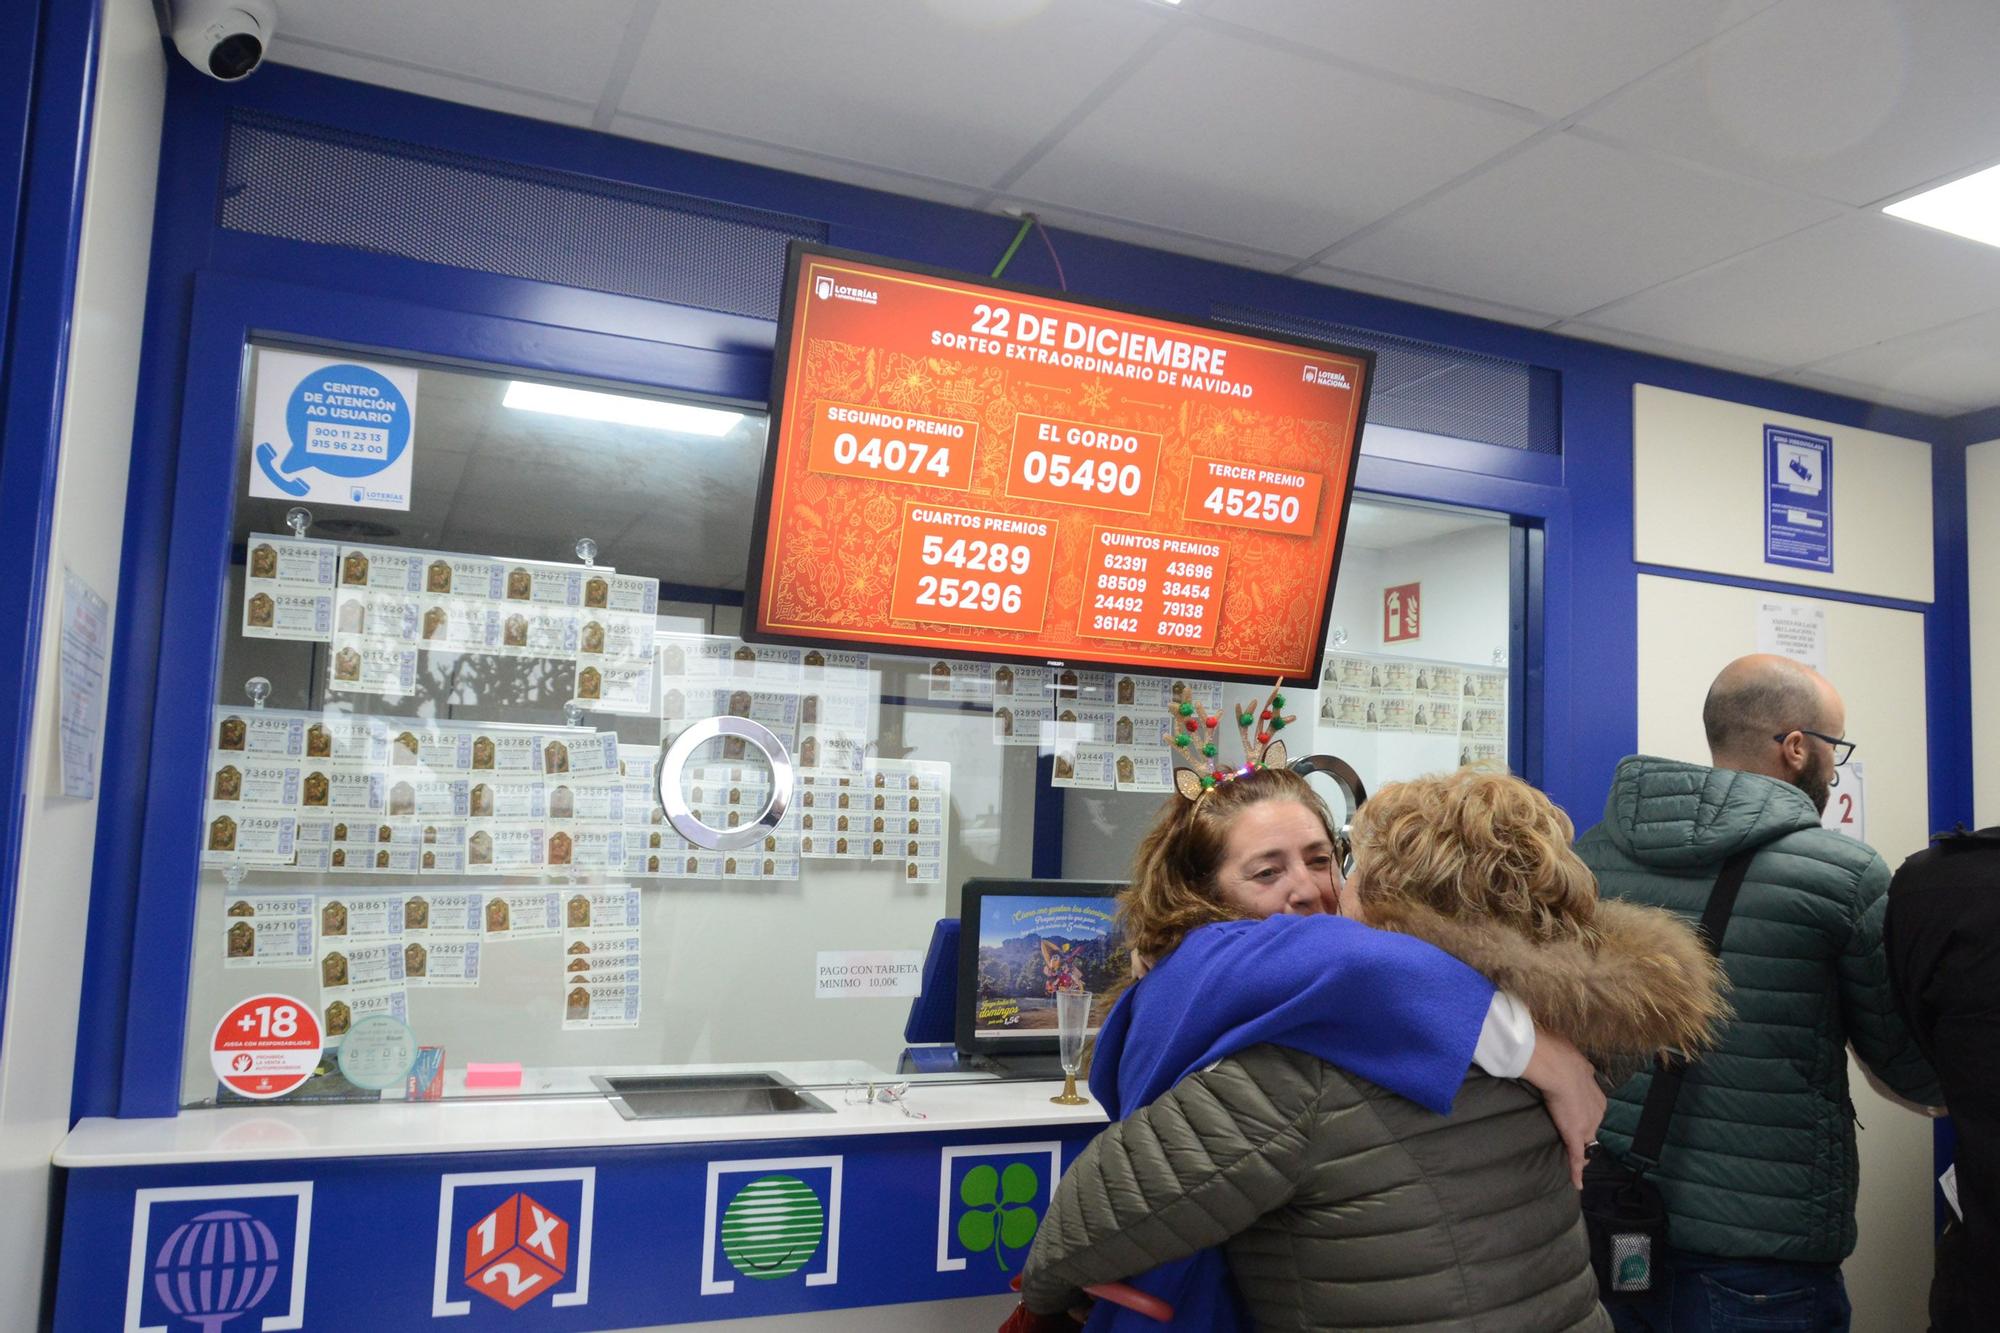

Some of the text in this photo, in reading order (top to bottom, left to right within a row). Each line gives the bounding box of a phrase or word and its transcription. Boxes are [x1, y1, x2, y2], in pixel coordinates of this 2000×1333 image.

[835, 285, 878, 299] LOTERÍAS
[971, 304, 1227, 376] 22 DE DICIEMBRE
[930, 330, 1253, 398] SORTEO EXTRAORDINARIO DE NAVIDAD
[1318, 370, 1345, 381] LOTERÍA
[323, 382, 380, 397] CENTRO
[1317, 378, 1351, 390] NACIONAL
[303, 392, 397, 412] DE ATENCIÓN
[306, 406, 392, 423] AO USUARIO
[827, 407, 964, 438] SEGUNDO PREMIO
[315, 427, 382, 442] 900 11 23 13
[1038, 423, 1138, 454] EL GORDO
[311, 439, 383, 454] 915 96 23 00
[833, 433, 950, 478] 04074
[1023, 450, 1142, 496] 05490
[1208, 463, 1305, 488] TERCER PREMIO
[1203, 486, 1300, 524] 45250
[911, 509, 1048, 536] CUARTOS PREMIOS
[1101, 532, 1220, 557] QUINTOS PREMIOS
[279, 547, 318, 557] 02444
[921, 534, 1031, 575] 54289
[370, 555, 408, 566] 01726
[1104, 553, 1213, 580] 62391 43696
[610, 578, 644, 590] 79500
[1097, 574, 1210, 600] 88509 38454
[915, 575, 1023, 614] 25296
[276, 596, 315, 606] 02444
[1094, 594, 1204, 619] 24492 79138
[1093, 615, 1203, 639] 36142 87092
[757, 649, 789, 660] 94710
[826, 654, 857, 663] 79500
[1078, 713, 1104, 721] 02444
[249, 719, 288, 729] 73409
[497, 738, 531, 747] 28786
[568, 739, 603, 750] 69485
[245, 769, 284, 779] 73409
[331, 775, 369, 785] 07188
[1839, 793, 1853, 823] 2
[240, 818, 279, 828] 73409
[494, 832, 529, 841] 28786
[573, 833, 608, 842] 93585
[256, 902, 296, 912] 01630
[349, 901, 387, 911] 08861
[256, 921, 296, 932] 94710
[429, 944, 465, 954] 76202
[592, 942, 625, 952] 32354
[349, 949, 386, 960] 99071
[820, 965, 918, 976] PAGO CON TARJETA
[592, 974, 625, 983] 02444
[820, 977, 898, 989] MINIMO 10,00€
[592, 988, 625, 997] 92044
[352, 997, 389, 1009] 99071
[979, 1006, 1019, 1019] domingos
[237, 1005, 298, 1038] +18
[477, 1205, 559, 1260] 1 X
[482, 1262, 543, 1298] 2
